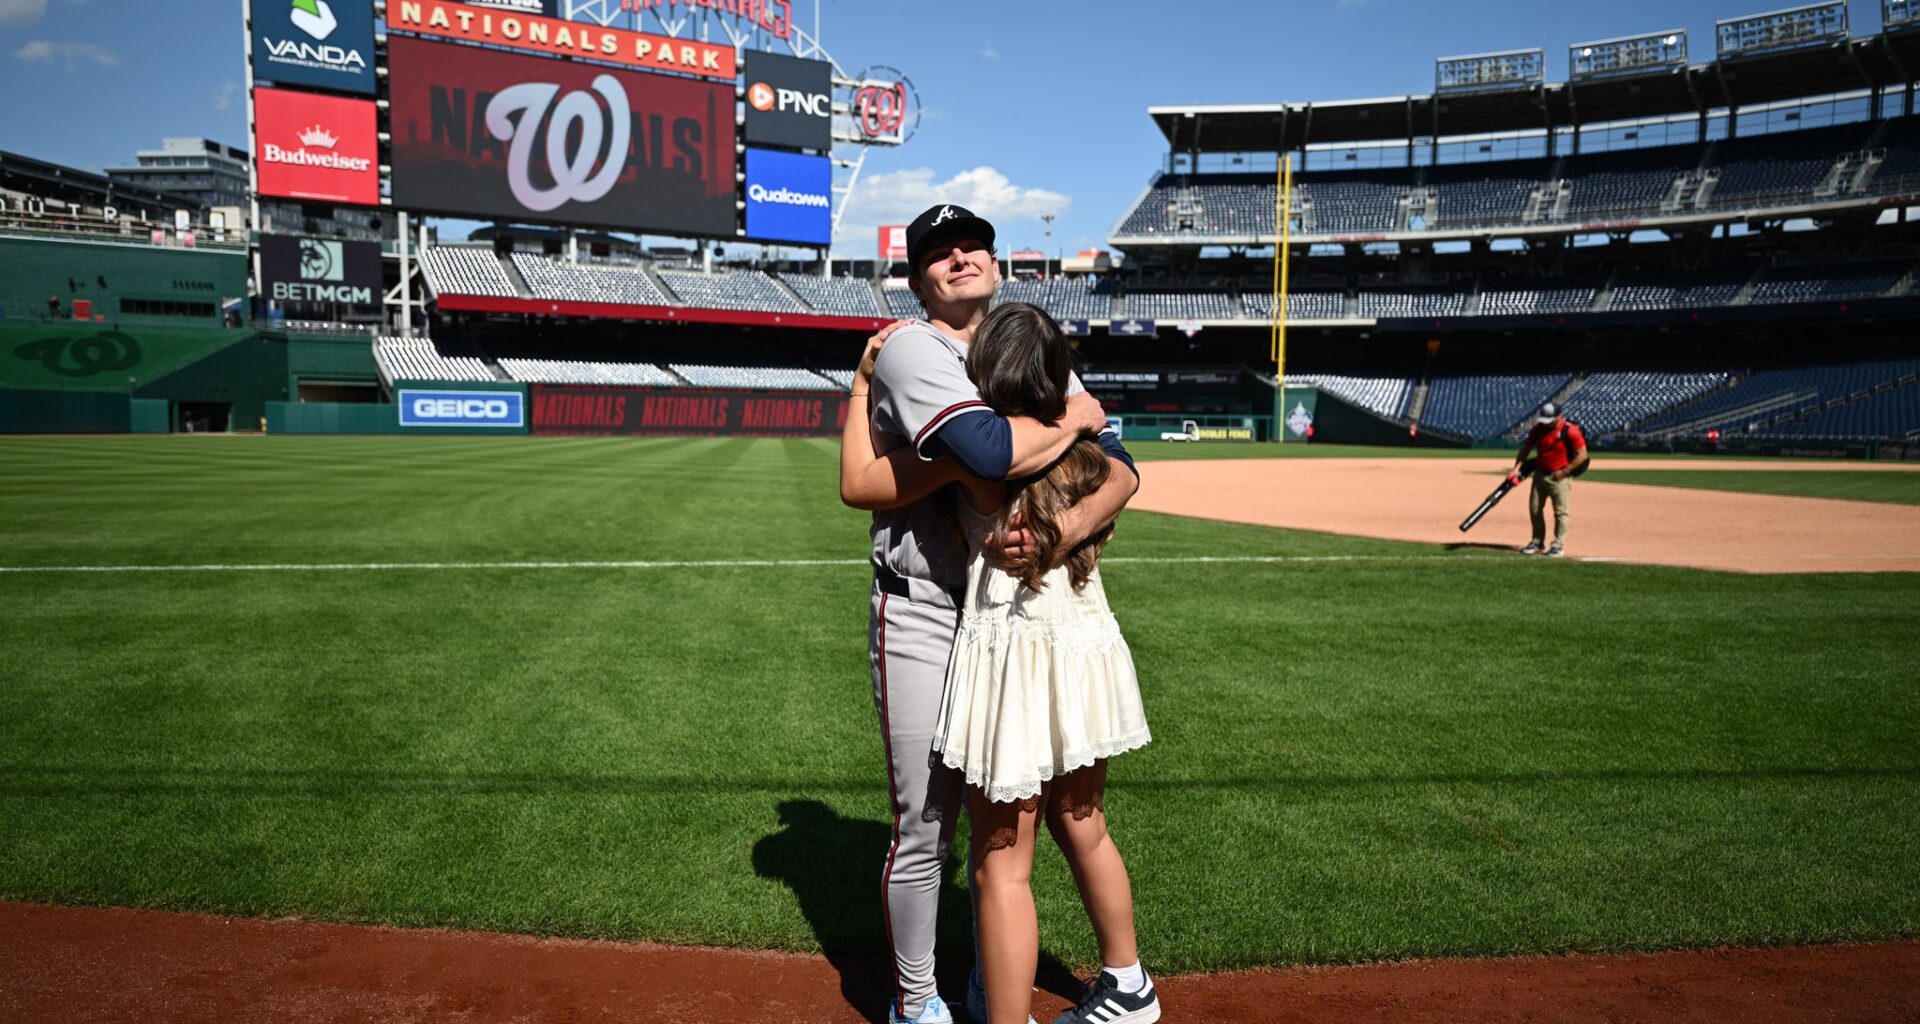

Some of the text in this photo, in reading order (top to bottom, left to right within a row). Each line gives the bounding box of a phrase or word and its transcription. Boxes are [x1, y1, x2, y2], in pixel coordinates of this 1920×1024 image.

[402, 3, 618, 55] NATIONALS
[636, 41, 721, 71] PARK
[263, 36, 366, 68] VANDA
[776, 88, 830, 118] PNC
[264, 143, 371, 172] Budweiser
[748, 183, 830, 208] Qualcomm
[273, 281, 371, 304] BETMGM
[413, 399, 509, 420] GEICO
[532, 395, 626, 426] NATIONALS
[642, 397, 728, 427] NATIONALS
[742, 399, 823, 428] NATIONALS
